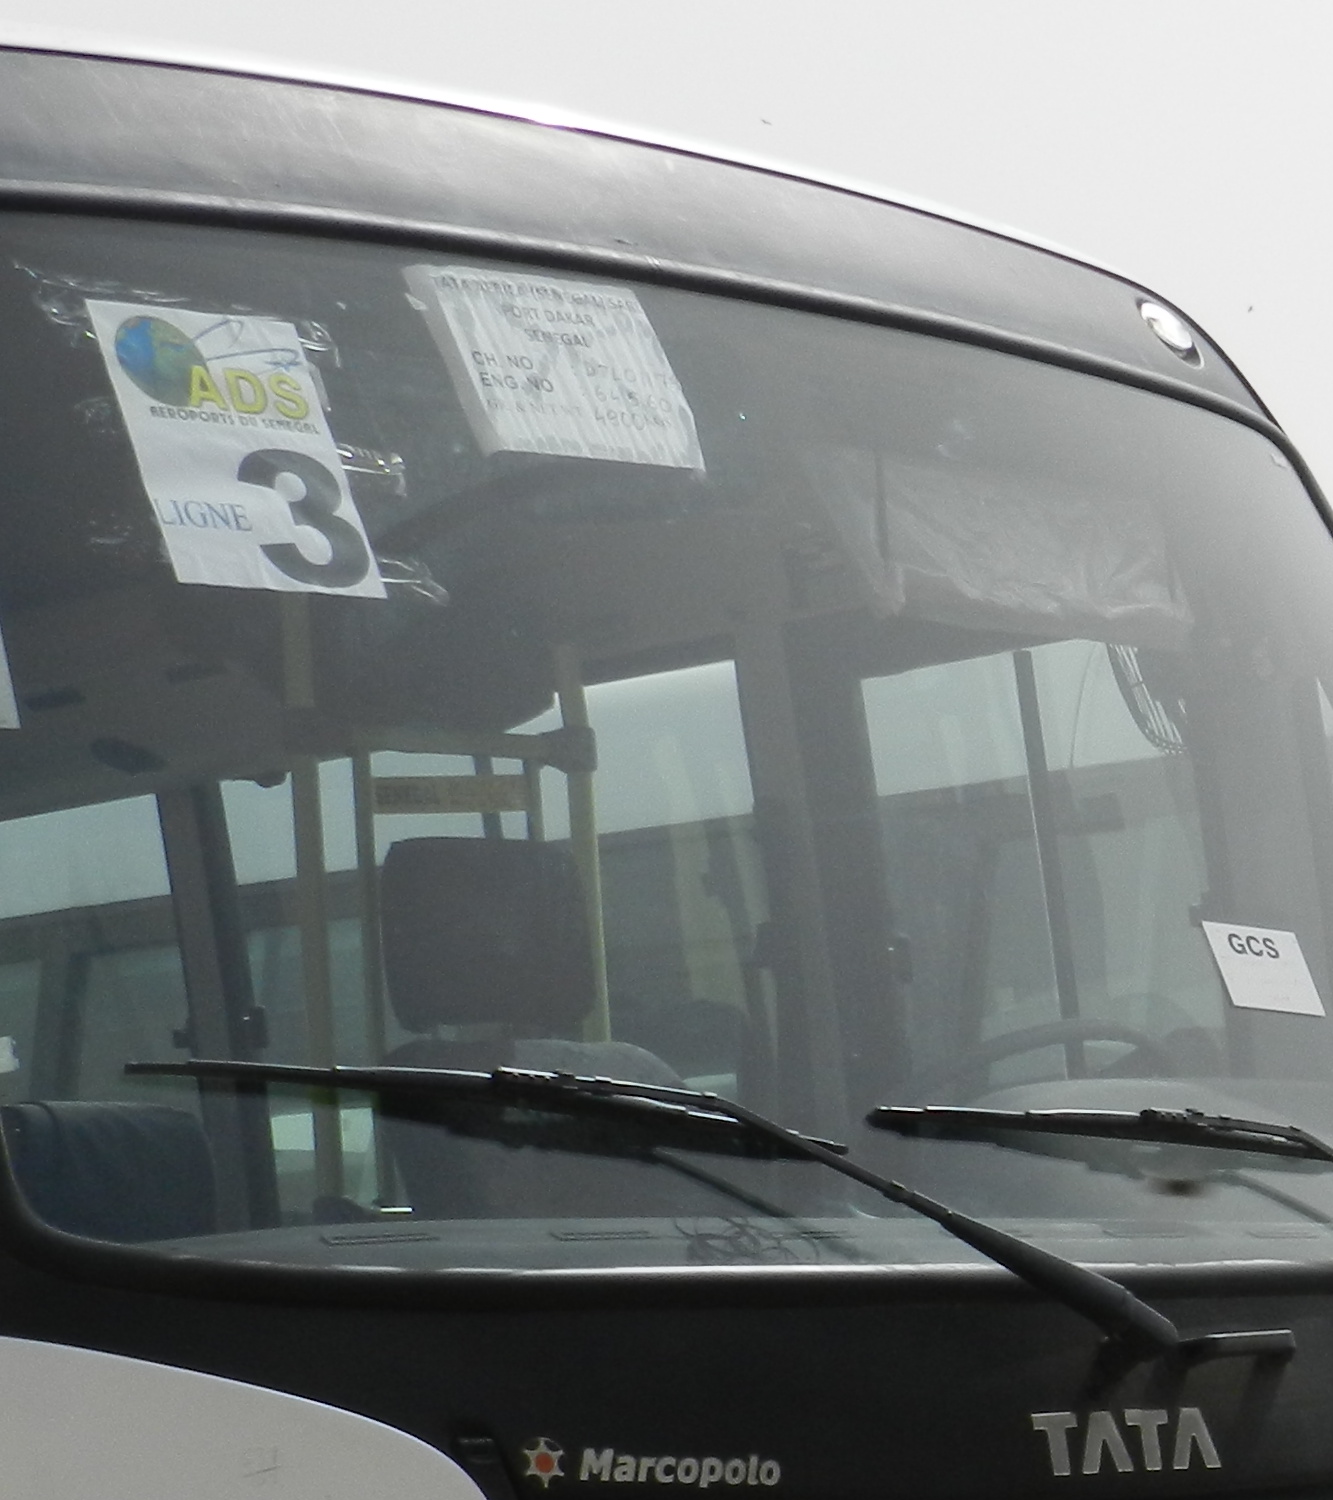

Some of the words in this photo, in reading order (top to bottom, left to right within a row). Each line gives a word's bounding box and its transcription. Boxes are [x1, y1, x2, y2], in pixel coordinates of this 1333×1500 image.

[544, 309, 596, 328] DAKAR
[523, 328, 591, 349] SENEGAL
[188, 364, 310, 421] ADS
[149, 405, 236, 426] AEROPORTS
[237, 415, 259, 427] DU
[153, 498, 253, 532] LIGNE
[236, 447, 371, 588] 3
[1227, 932, 1280, 959] GCS
[1031, 1407, 1222, 1477] TATA
[580, 1447, 782, 1488] Marcopolo
